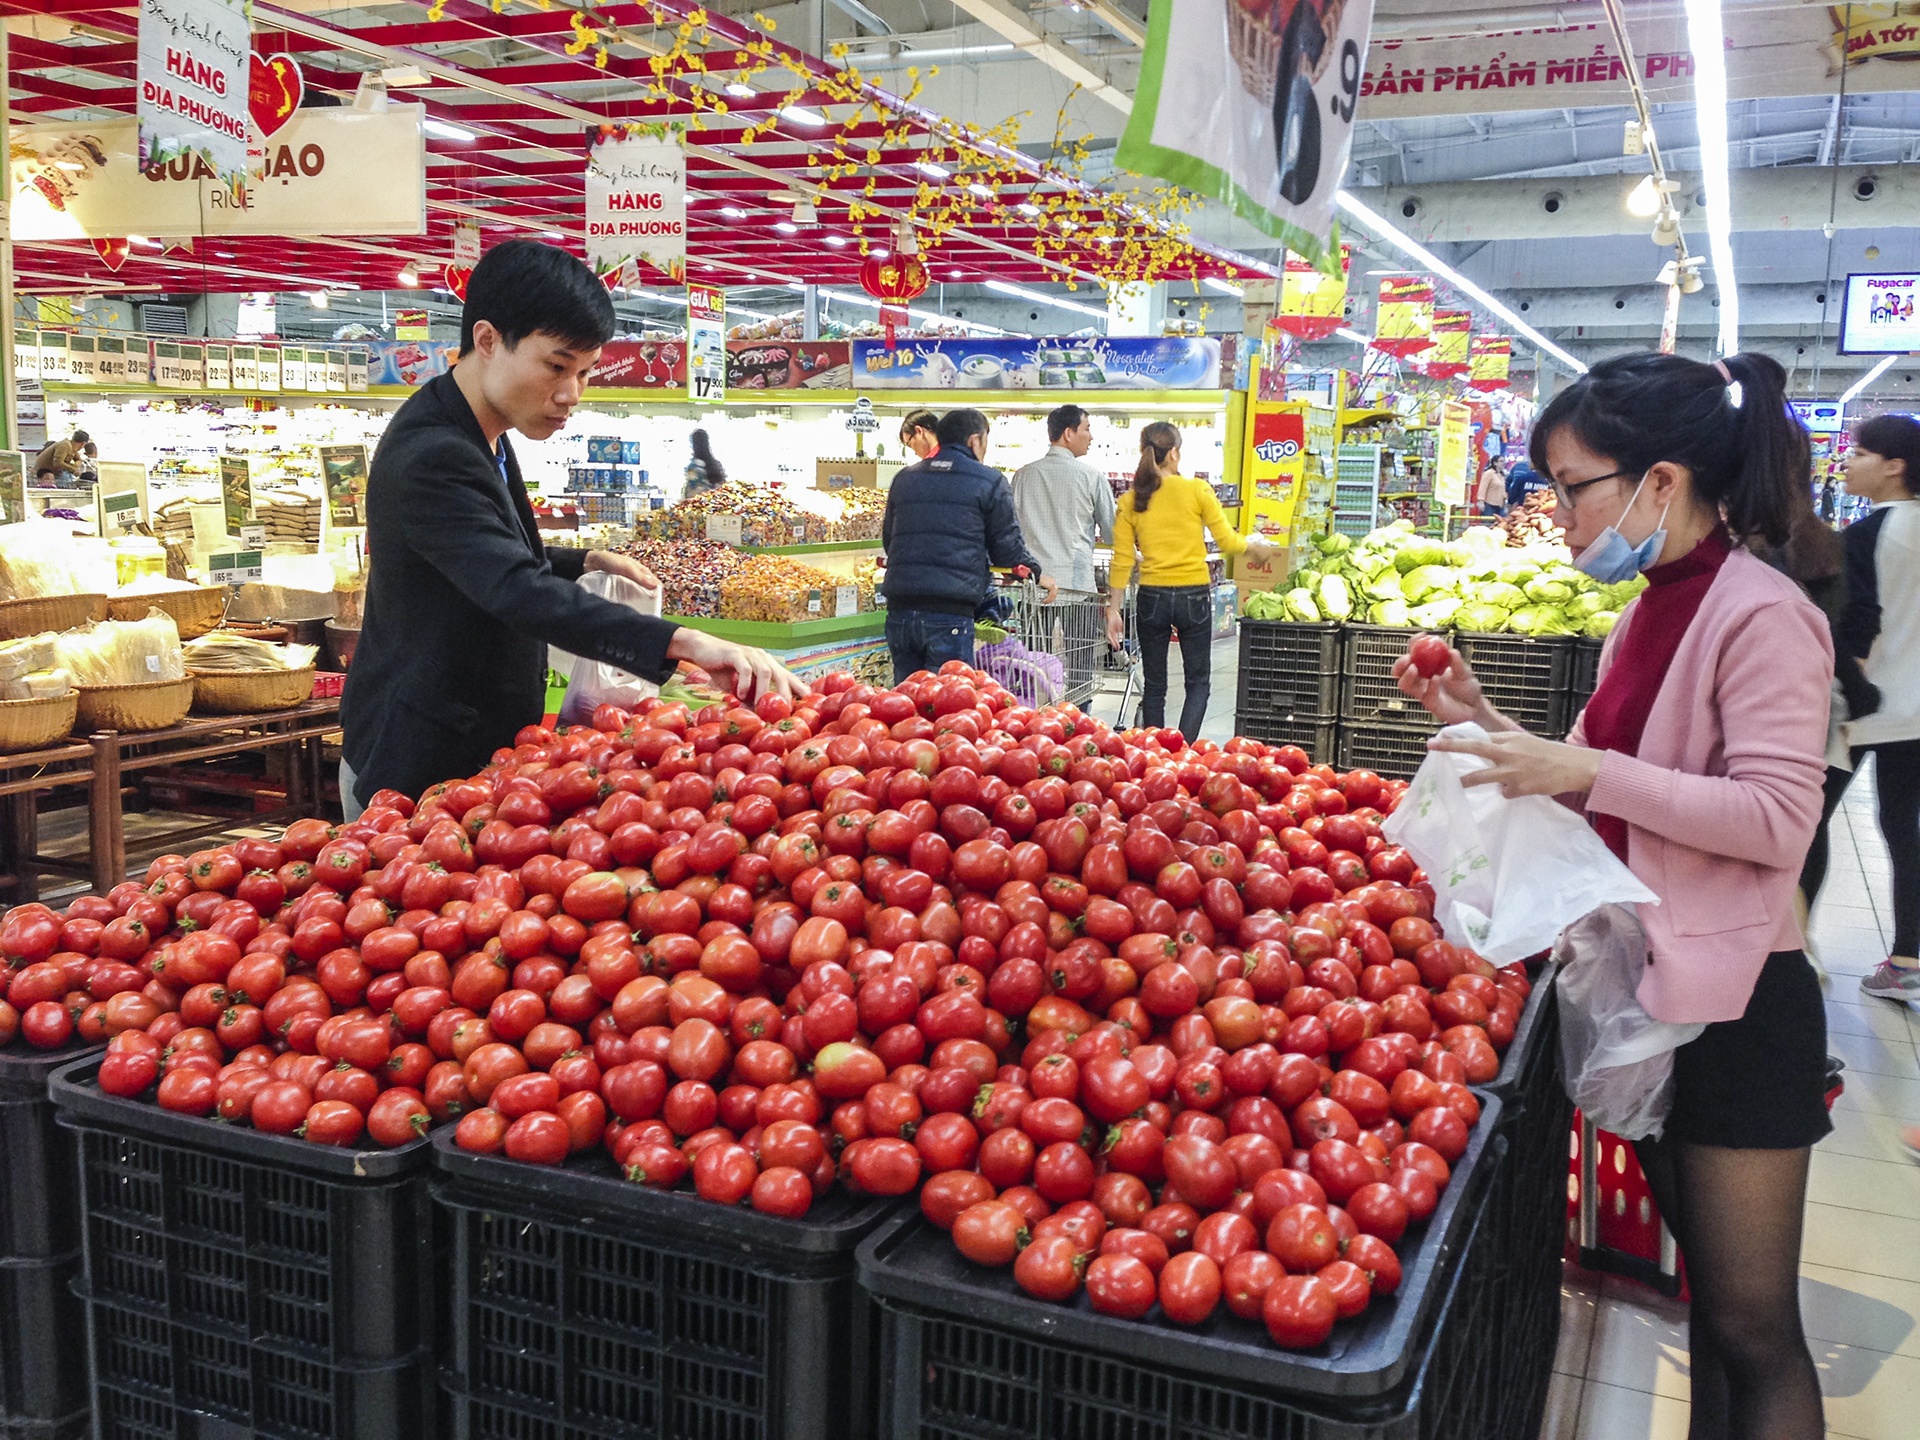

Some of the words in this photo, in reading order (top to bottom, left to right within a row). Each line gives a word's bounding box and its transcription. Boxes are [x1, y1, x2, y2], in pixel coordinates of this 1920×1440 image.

[1878, 22, 1920, 44] TỐT
[166, 47, 226, 95] HÀNG
[1359, 62, 1425, 97] SẢN
[1433, 51, 1537, 92] PHẨM
[143, 80, 174, 111] ĐỊA
[178, 94, 245, 140] PHƯƠNG
[608, 189, 663, 210] HÀNG
[589, 222, 616, 238] ĐỊA
[619, 220, 682, 236] PHƯƠNG
[1867, 279, 1916, 290] Fugacar
[43, 356, 55, 370] 33
[71, 360, 83, 374] 32
[99, 360, 112, 375] 44
[209, 367, 219, 380] 22
[694, 376, 711, 397] 17
[116, 511, 125, 521] 16
